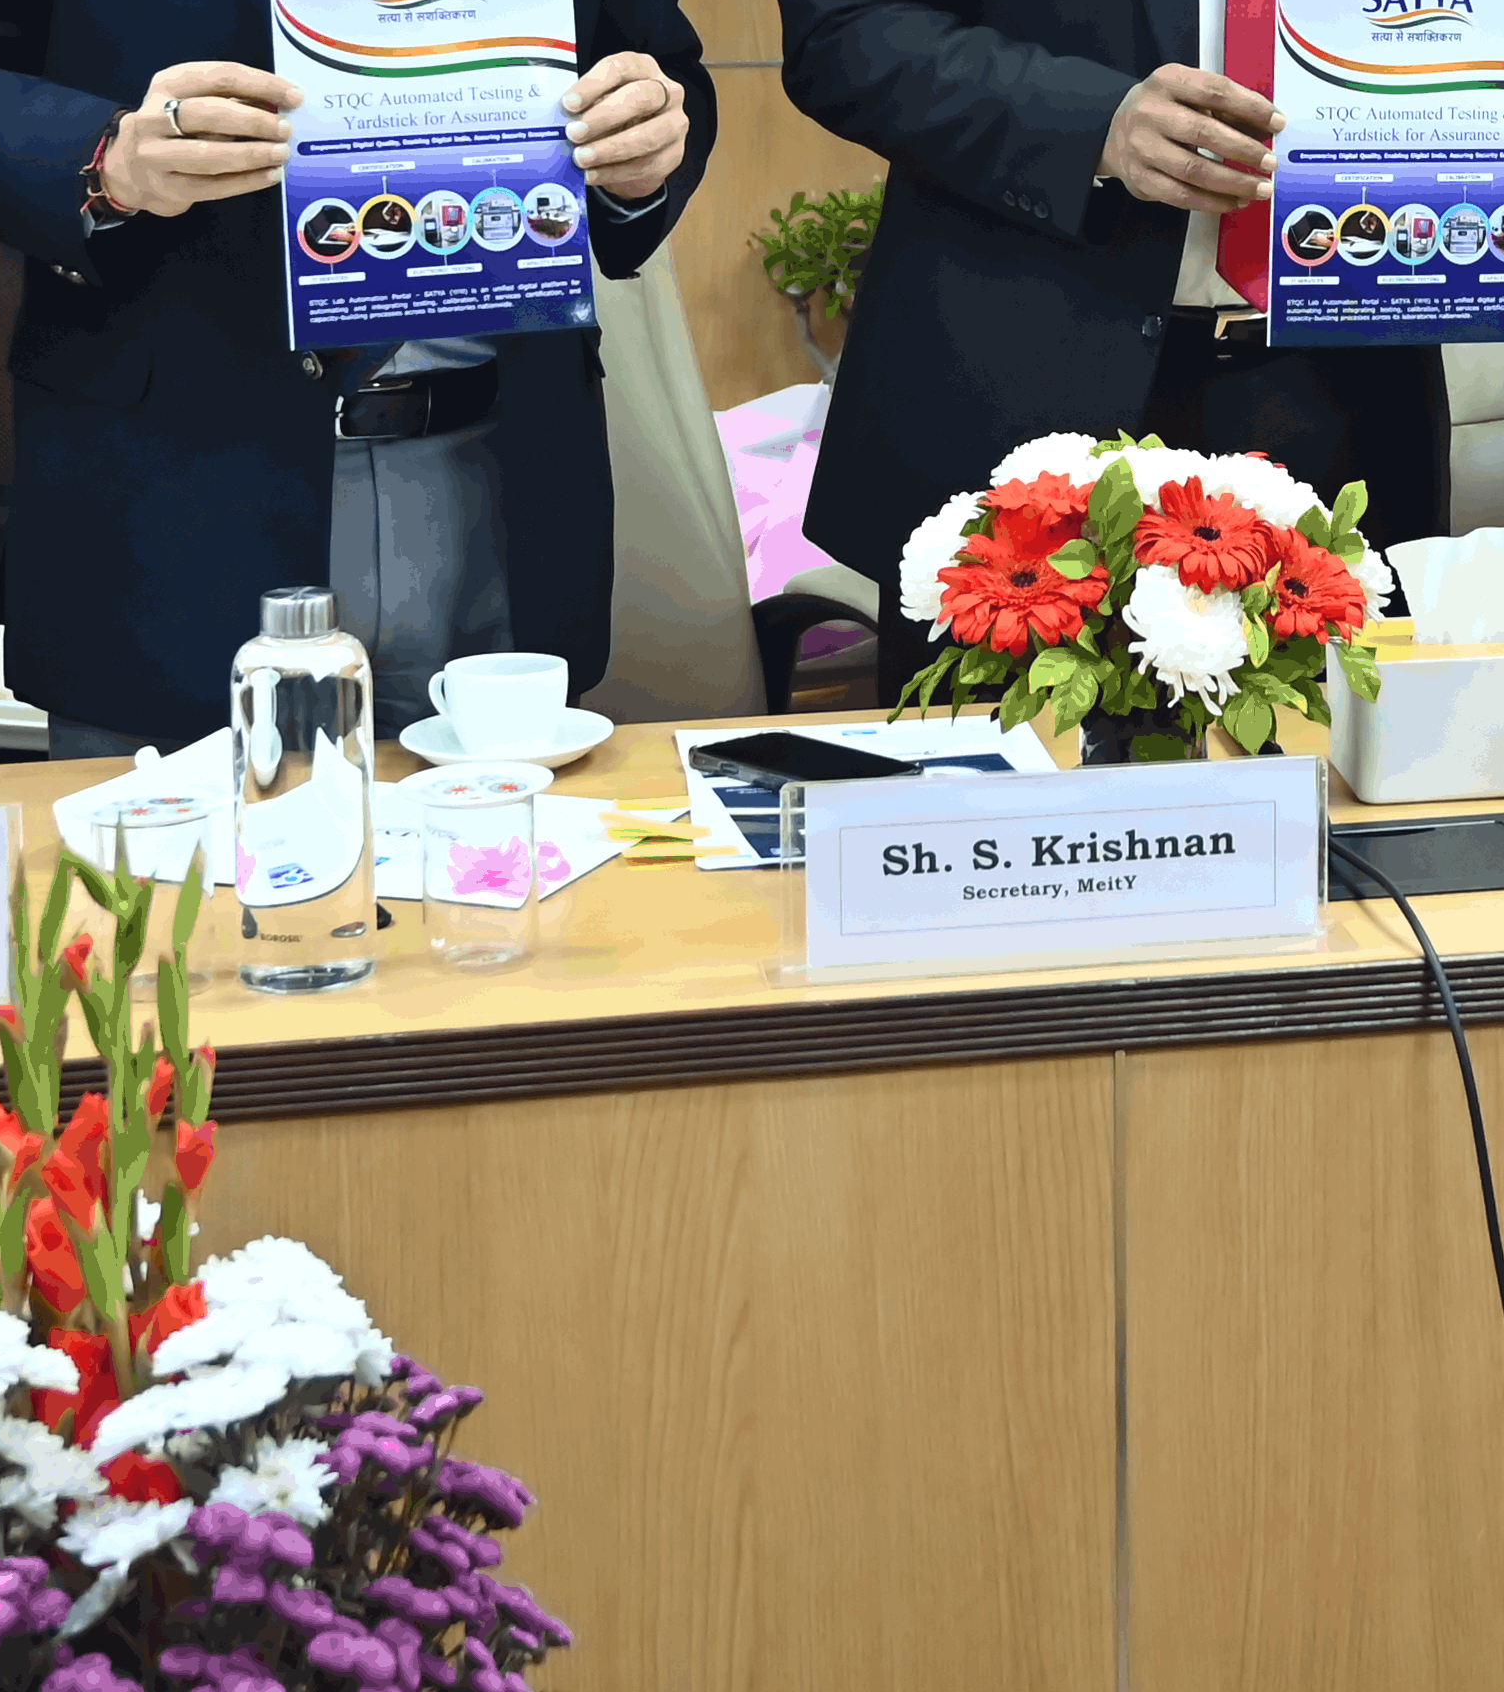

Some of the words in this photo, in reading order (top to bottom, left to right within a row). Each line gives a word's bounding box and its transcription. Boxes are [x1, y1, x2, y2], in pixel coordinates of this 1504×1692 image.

[324, 94, 372, 110] STQC
[380, 89, 463, 106] Automated
[468, 86, 524, 103] Testing
[528, 84, 541, 98] &
[343, 115, 418, 131] Yardstick
[423, 112, 446, 128] for
[450, 109, 528, 125] Assurance
[1316, 107, 1362, 122] STQC
[1366, 107, 1444, 121] Automated
[1448, 107, 1498, 123] Testing
[1332, 128, 1399, 143] Yardstick
[1405, 128, 1425, 142] for
[1429, 128, 1500, 142] Assurance
[882, 843, 954, 876] Sh.
[972, 839, 1012, 871] S.
[1032, 828, 1236, 867] Krishnan
[963, 881, 1070, 901] Secretary,
[1077, 875, 1137, 893] MeitY
